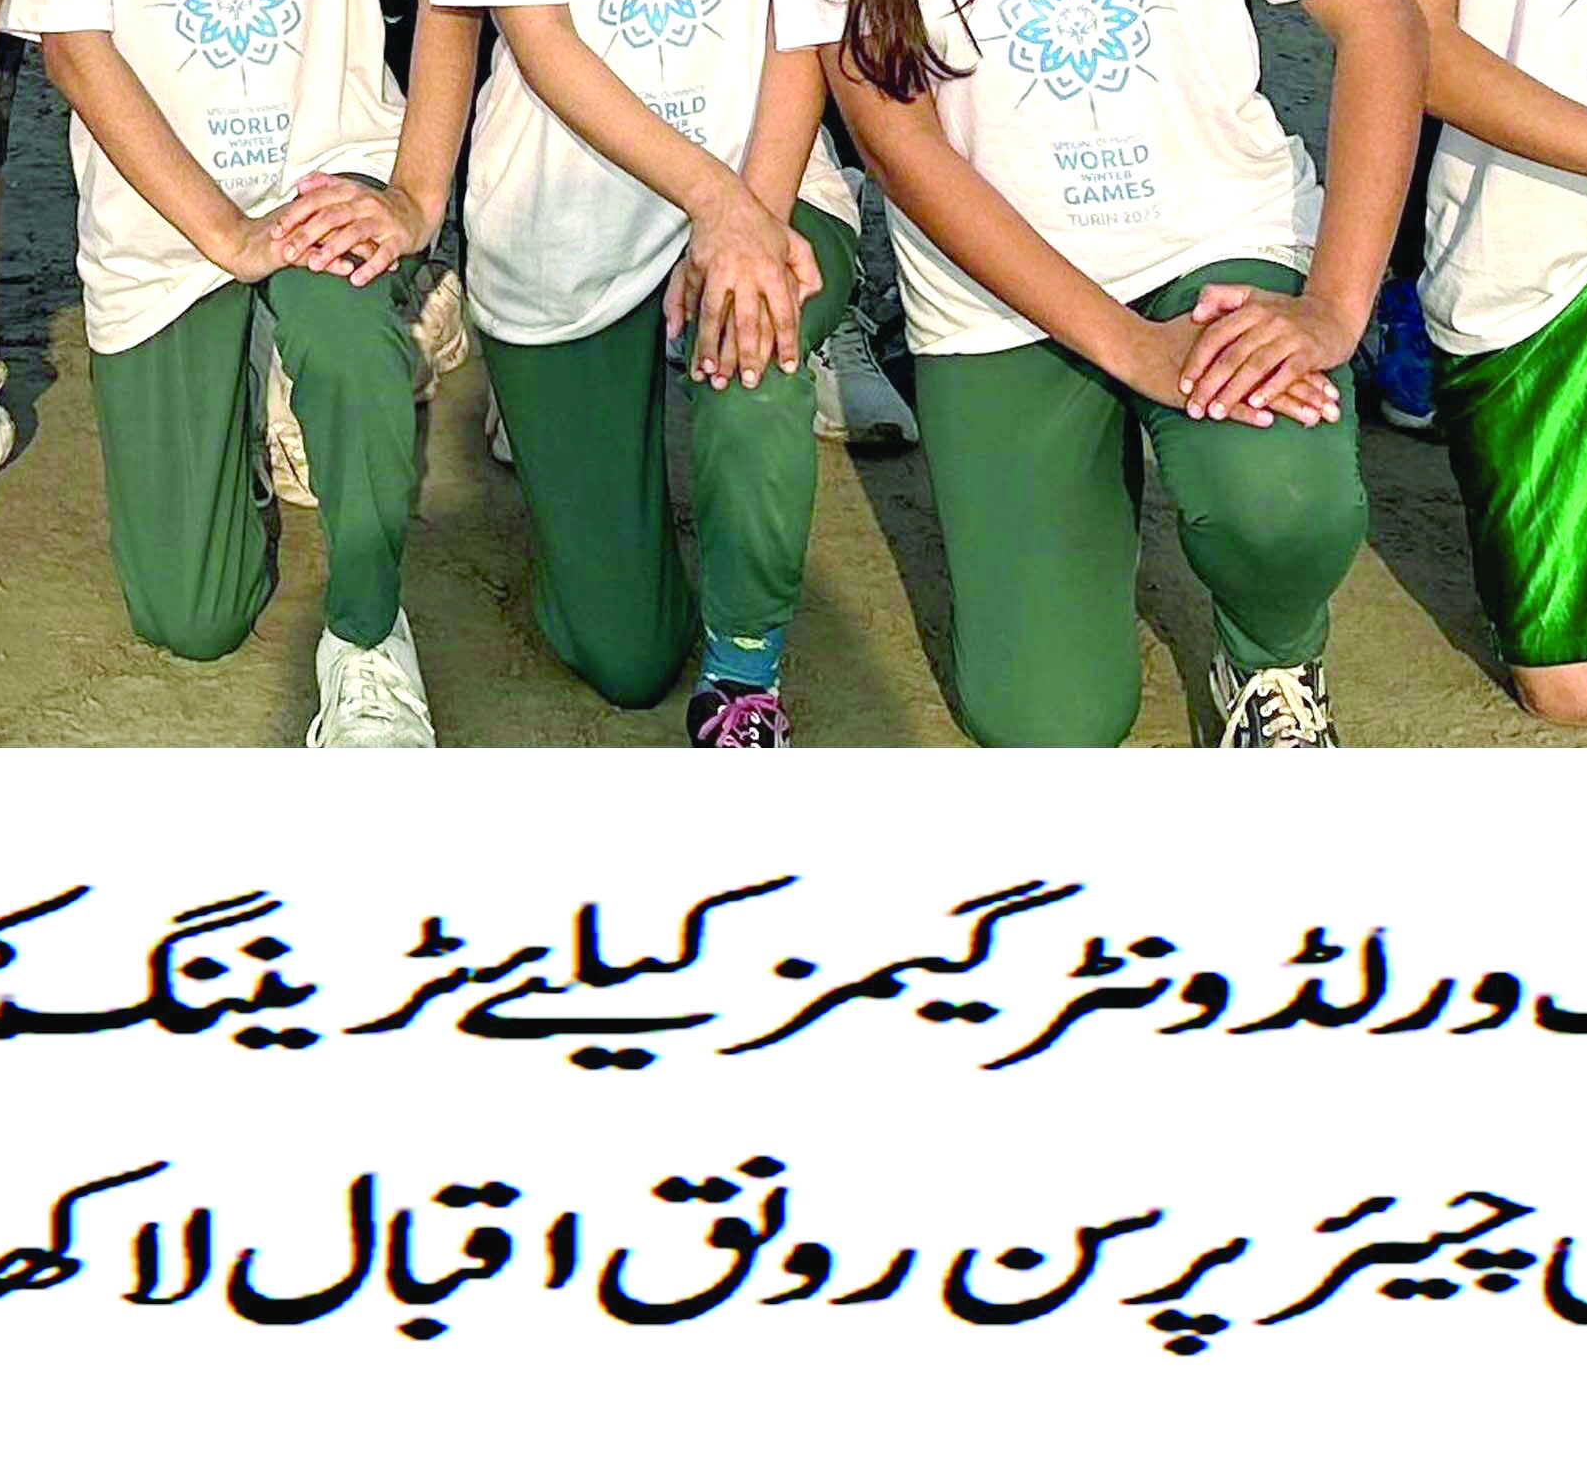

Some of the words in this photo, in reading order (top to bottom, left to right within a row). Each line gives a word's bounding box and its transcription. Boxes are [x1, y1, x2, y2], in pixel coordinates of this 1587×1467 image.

[207, 112, 290, 135] WORLD
[213, 142, 289, 169] GAMES
[1054, 144, 1149, 170] WORLD
[1063, 179, 1156, 206] GAMES
